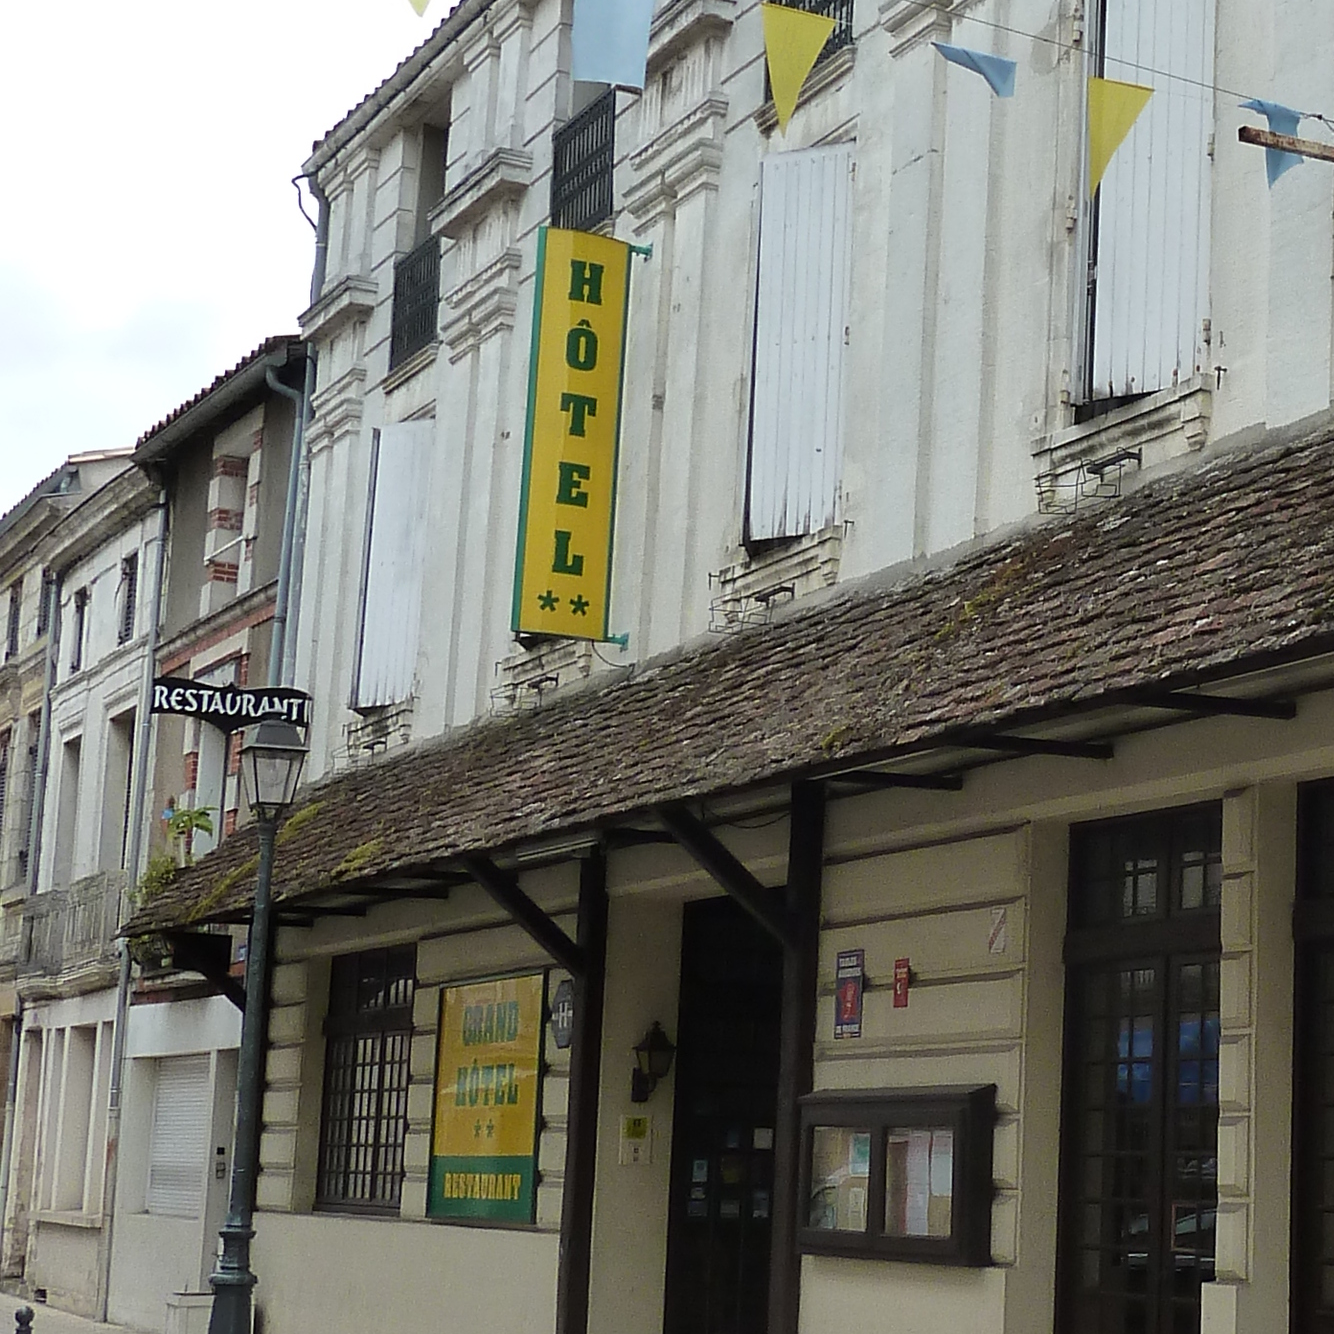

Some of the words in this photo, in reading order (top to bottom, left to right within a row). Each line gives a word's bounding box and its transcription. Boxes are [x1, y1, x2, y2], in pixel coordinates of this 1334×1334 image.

[551, 259, 605, 577] HÔTEL
[154, 685, 303, 721] RESTAURANT
[462, 1000, 519, 1047] GRAND
[455, 1058, 519, 1107] HÔTEL
[443, 1172, 522, 1201] RESTAURANT
